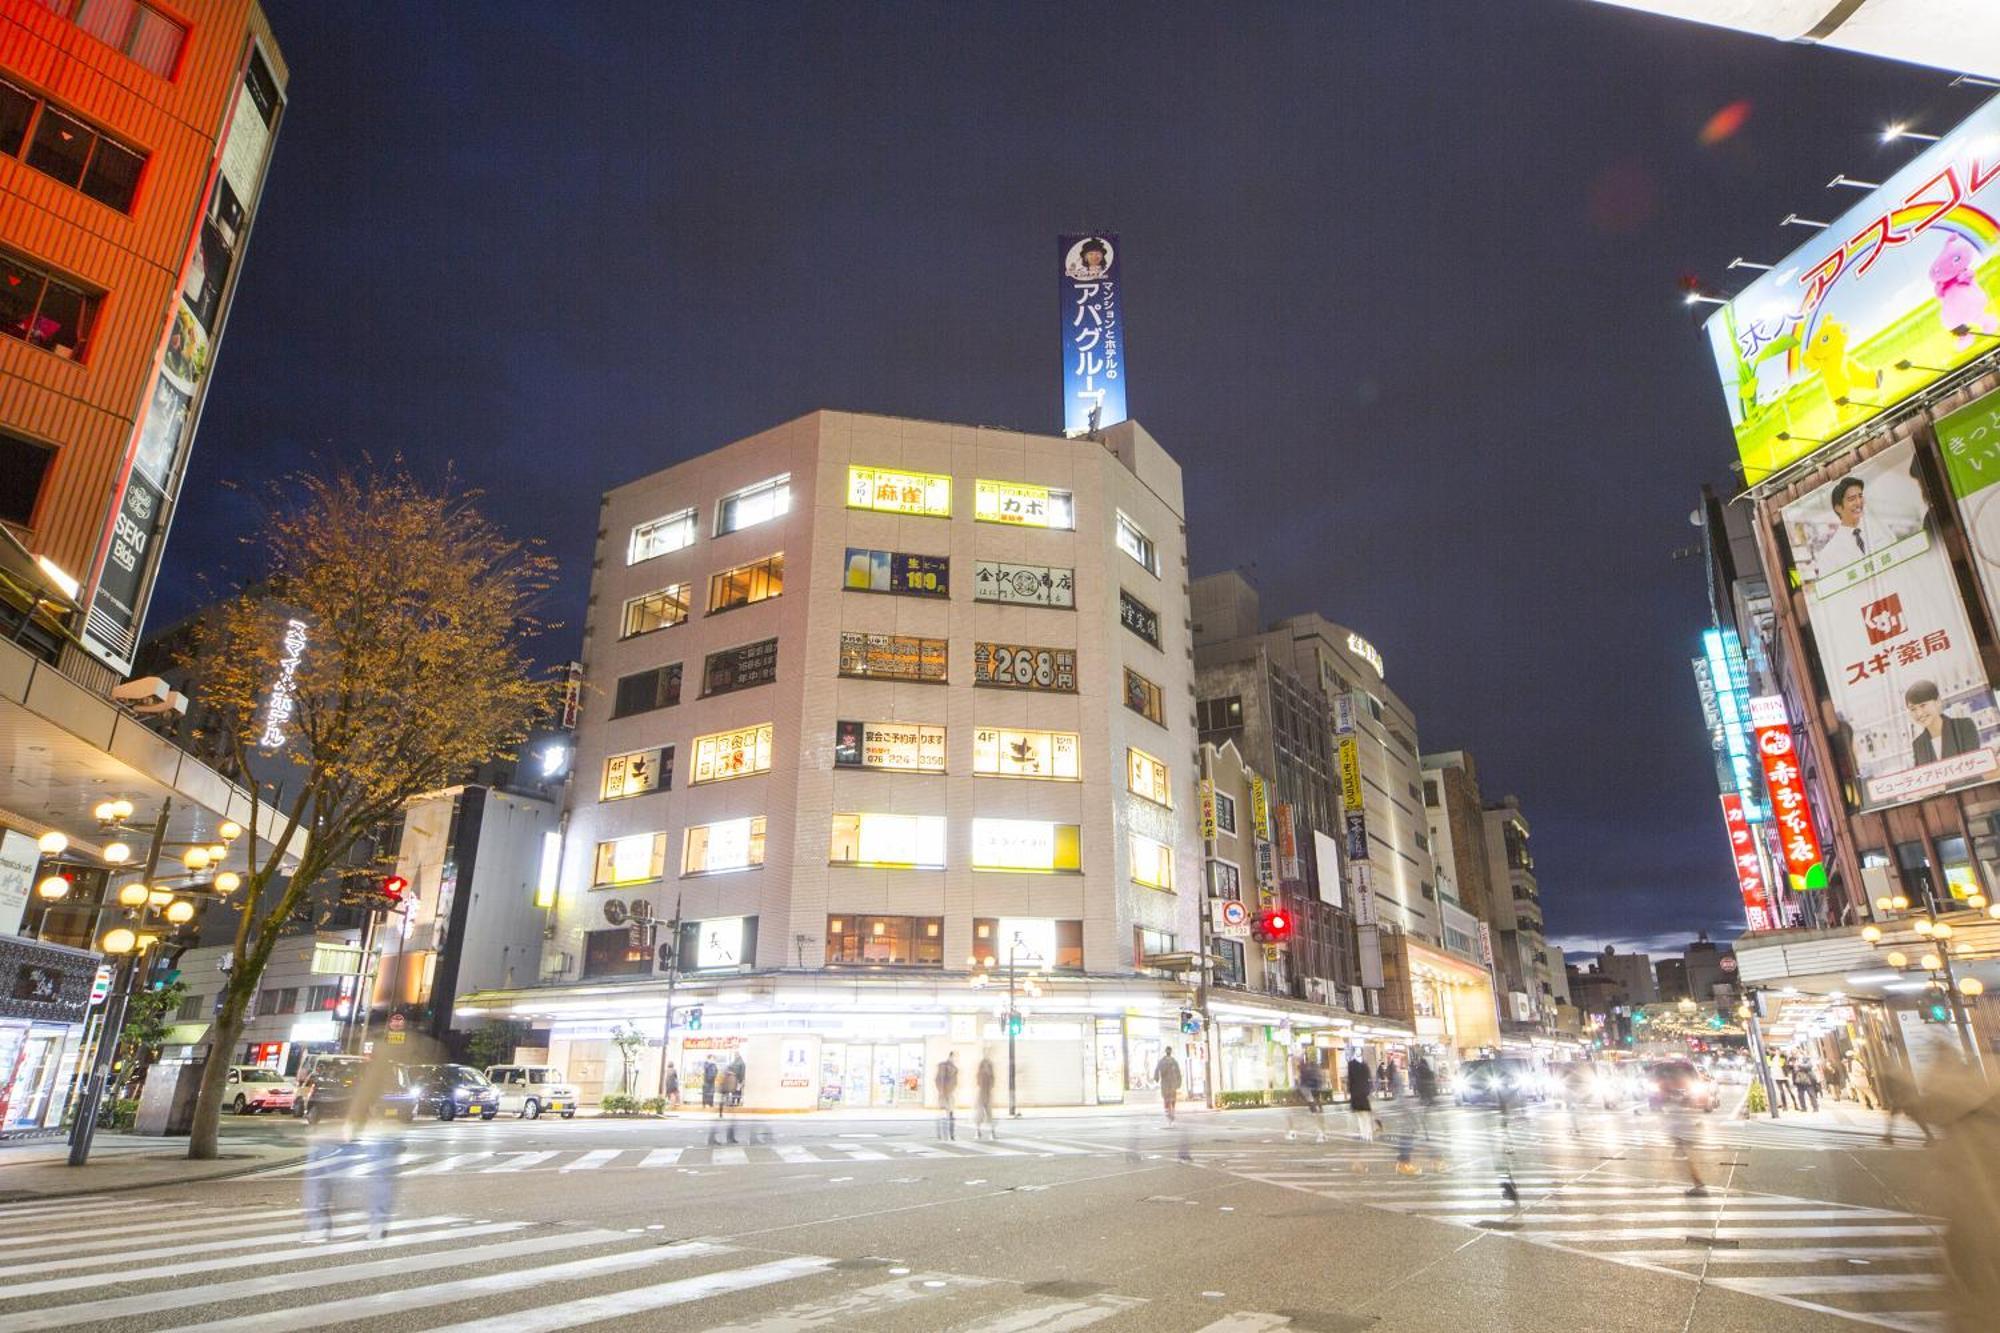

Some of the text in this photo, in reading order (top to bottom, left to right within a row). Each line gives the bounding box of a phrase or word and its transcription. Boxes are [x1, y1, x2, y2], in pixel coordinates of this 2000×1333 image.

[1073, 283, 1106, 409] アパグループ
[1102, 281, 1118, 380] マンションとホテルの
[877, 484, 922, 502] 麻雀
[1004, 498, 1044, 515] カボ
[115, 512, 147, 554] SEKI
[113, 539, 136, 572] Bldg
[976, 568, 1012, 584] 金沢
[993, 648, 1056, 687] 268
[1846, 629, 1951, 685] スギ薬局
[1752, 700, 1784, 714] KIRIN
[866, 731, 943, 745] 宴会ご予約承ります
[1874, 757, 1988, 795] ビューティアドバイザー
[1769, 761, 1814, 862] 赤玉本店
